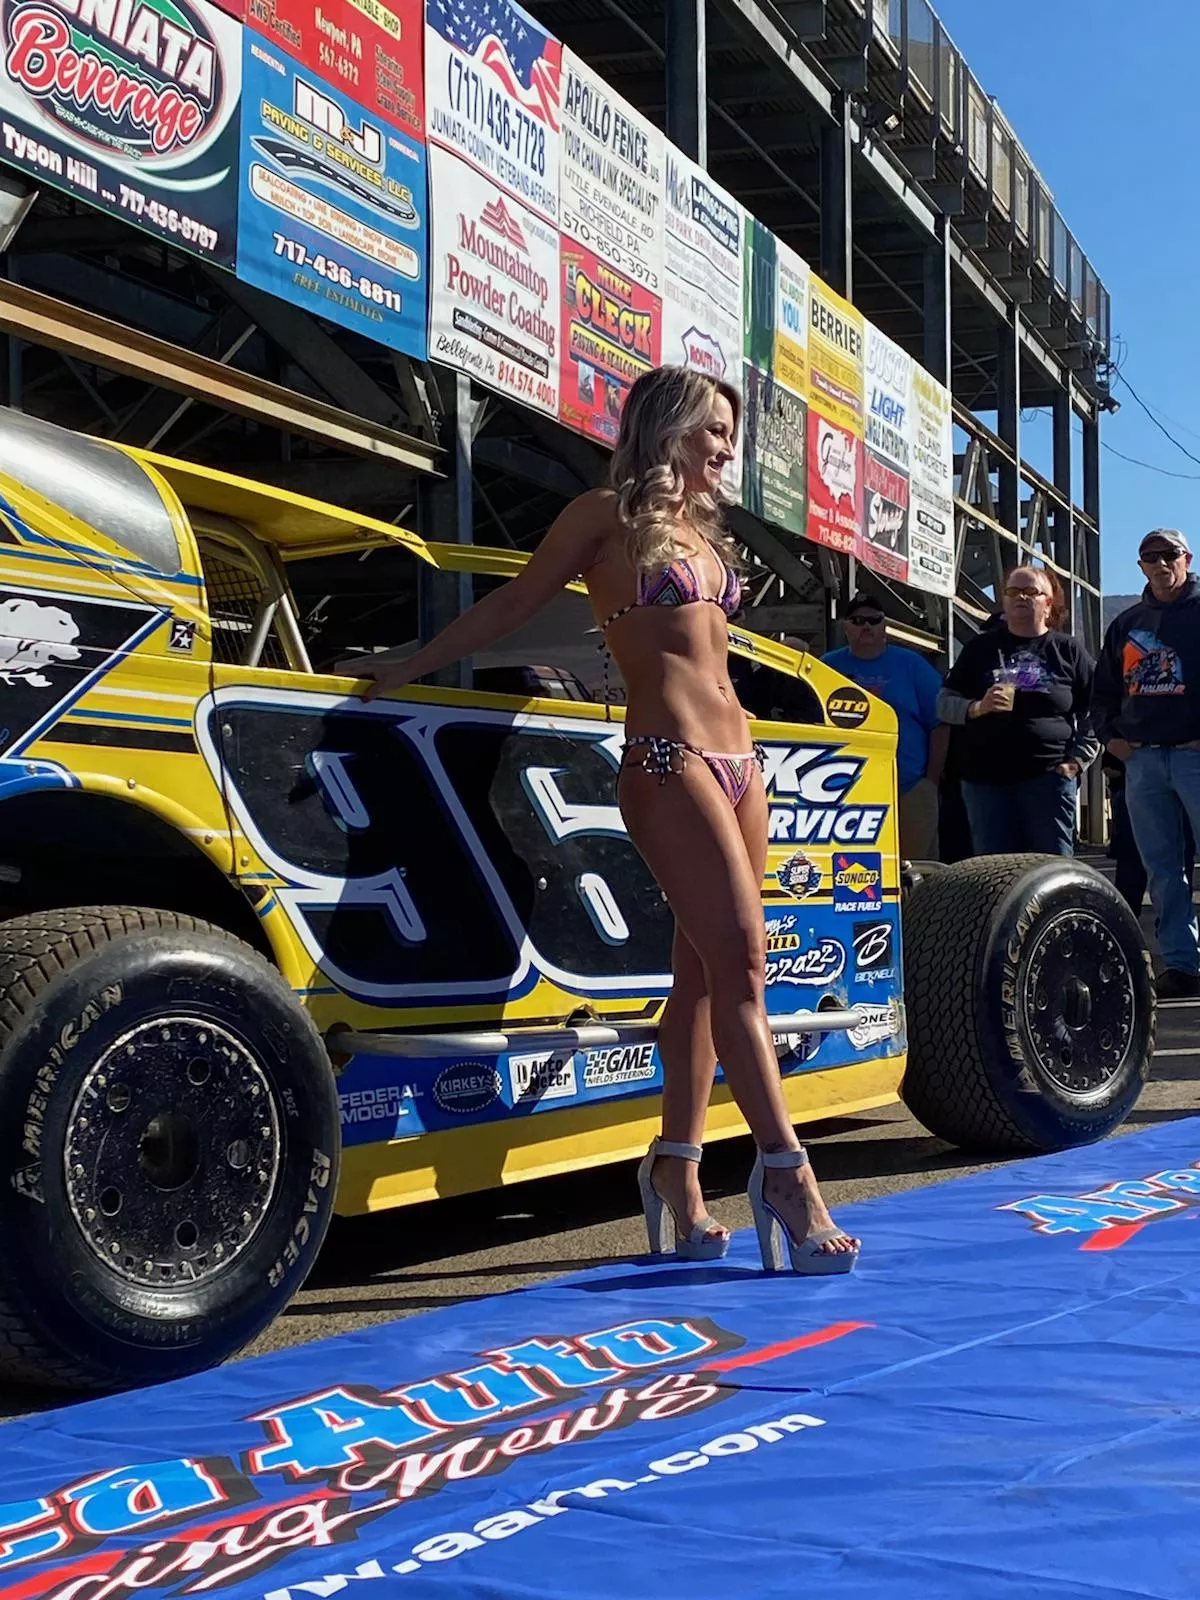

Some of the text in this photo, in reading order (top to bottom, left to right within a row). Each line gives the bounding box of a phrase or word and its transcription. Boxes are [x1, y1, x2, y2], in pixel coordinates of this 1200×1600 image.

[64, 0, 213, 99] NIATA
[351, 33, 362, 60] PA
[11, 10, 201, 149] Beverage
[448, 52, 545, 178] (717) 436-7728
[563, 71, 612, 147] APOLLO
[613, 108, 649, 177] FENCE
[262, 102, 309, 144] PAVING
[312, 135, 323, 150] &
[388, 177, 410, 200] LLC
[431, 107, 557, 217] JUNIATA COUNTY VETERANS AFFAIRS
[581, 143, 601, 181] CHAIN
[602, 158, 617, 194] LINK
[3, 122, 62, 174] Tyson
[67, 156, 98, 193] Hill
[119, 184, 218, 250] 717-436-8787
[564, 167, 590, 194] LITTLE
[592, 188, 638, 229] EVENDALE
[272, 231, 401, 313] 717-436-8811
[458, 212, 549, 309] Mountaintop
[563, 212, 659, 289] 570-850-3973
[627, 234, 642, 255] PA
[293, 272, 384, 322] FREE ESTIMATES
[447, 252, 506, 319] Powder
[509, 290, 556, 358] Coating
[596, 265, 633, 300] MIKE
[572, 330, 600, 359] PAVING
[575, 270, 652, 359] CLECK
[811, 297, 862, 361] BERRIER
[498, 360, 557, 408] 814.574.4003
[866, 333, 910, 398] BUSCH
[870, 385, 905, 430] LIGHT
[768, 808, 886, 843] RVICE
[835, 901, 881, 912] RACE FUELS
[766, 935, 798, 951] IZZA
[855, 967, 896, 983] BICKNELL
[1001, 894, 1041, 1094] AMERICAN
[860, 1010, 897, 1026] ONES
[10, 977, 125, 1203] AMERICAN
[439, 1075, 486, 1092] KIRKEY
[530, 1057, 564, 1078] Auto
[530, 1072, 572, 1091] Meter
[605, 1046, 653, 1073] GME
[615, 1066, 656, 1083] STEERINGS
[282, 1086, 299, 1118] 2025
[340, 1084, 424, 1108] FEDERAL
[340, 1101, 409, 1124] MOGUL
[267, 1148, 333, 1289] RACER
[993, 1167, 1200, 1234] Are
[246, 1318, 719, 1477] Auto
[45, 1370, 718, 1600] cing News
[262, 1412, 827, 1600] w.aarn.com
